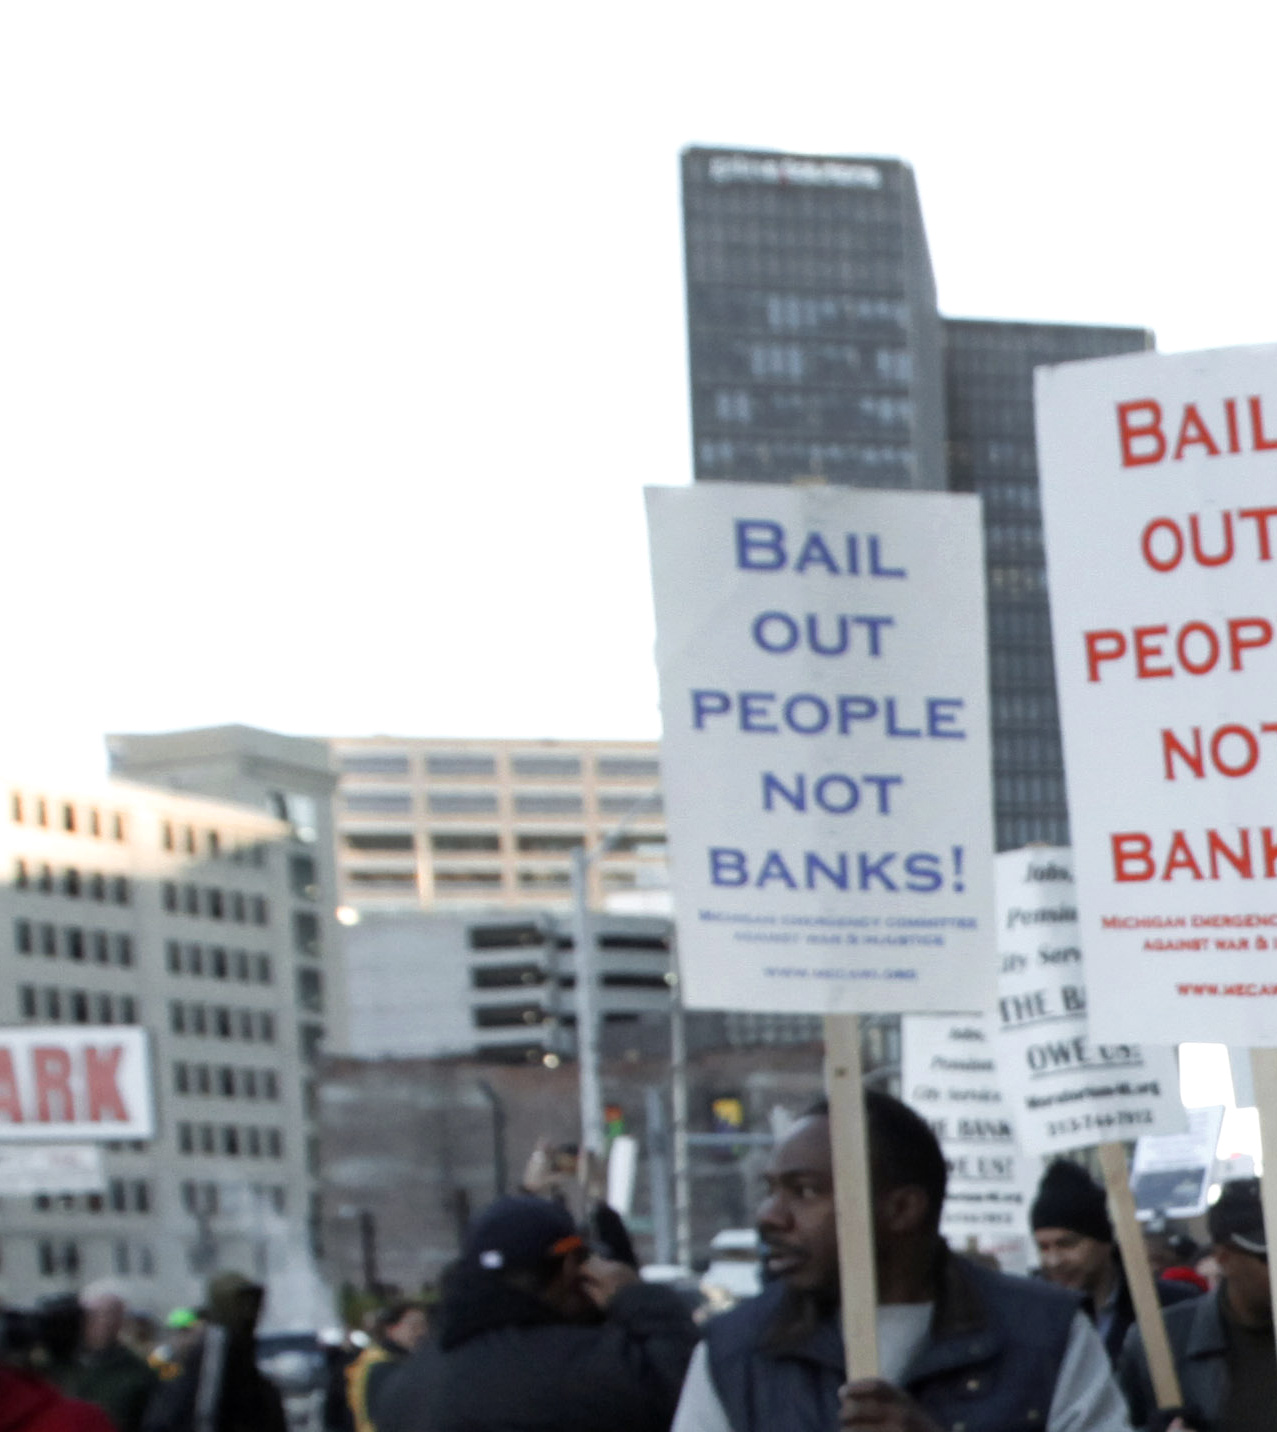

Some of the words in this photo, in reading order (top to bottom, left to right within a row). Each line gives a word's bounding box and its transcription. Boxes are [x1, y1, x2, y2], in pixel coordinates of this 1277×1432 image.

[733, 518, 907, 579] BAIL
[752, 611, 893, 657] OUT
[689, 689, 967, 738] PEOPLE
[761, 772, 903, 815] NOT
[708, 845, 966, 892] BANKS!
